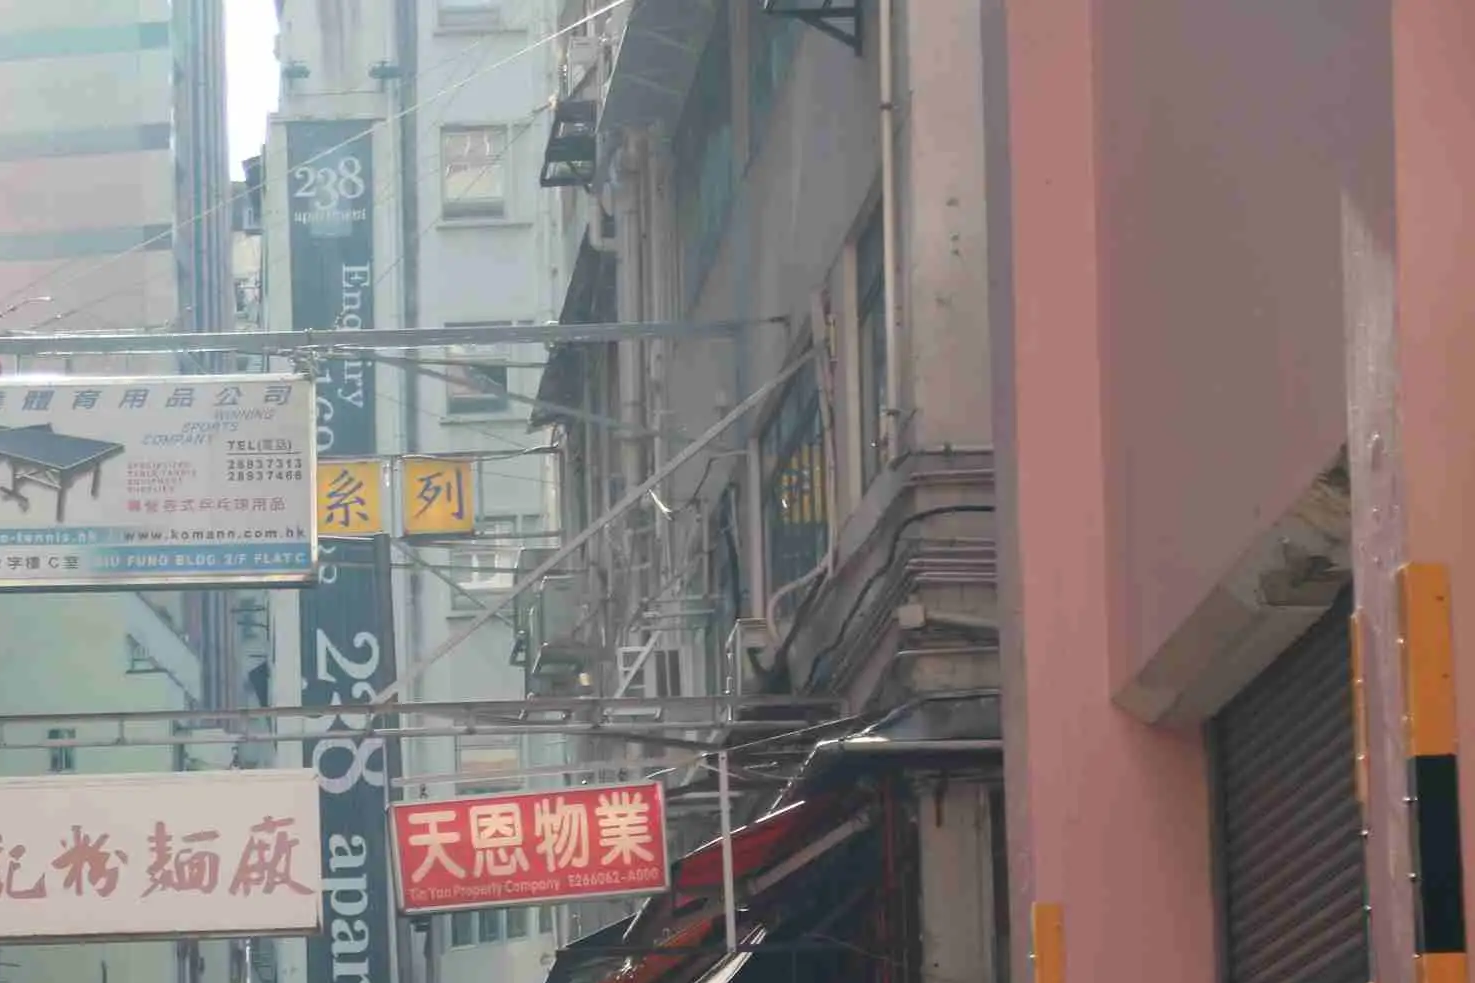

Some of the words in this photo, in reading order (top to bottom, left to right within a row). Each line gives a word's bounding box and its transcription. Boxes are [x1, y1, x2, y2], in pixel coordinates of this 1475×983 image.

[293, 156, 365, 210] 238
[341, 262, 370, 410] Enqiry
[126, 527, 306, 542] www.komann.com.hk
[408, 792, 655, 882] 天恩物業
[504, 876, 560, 893] Company
